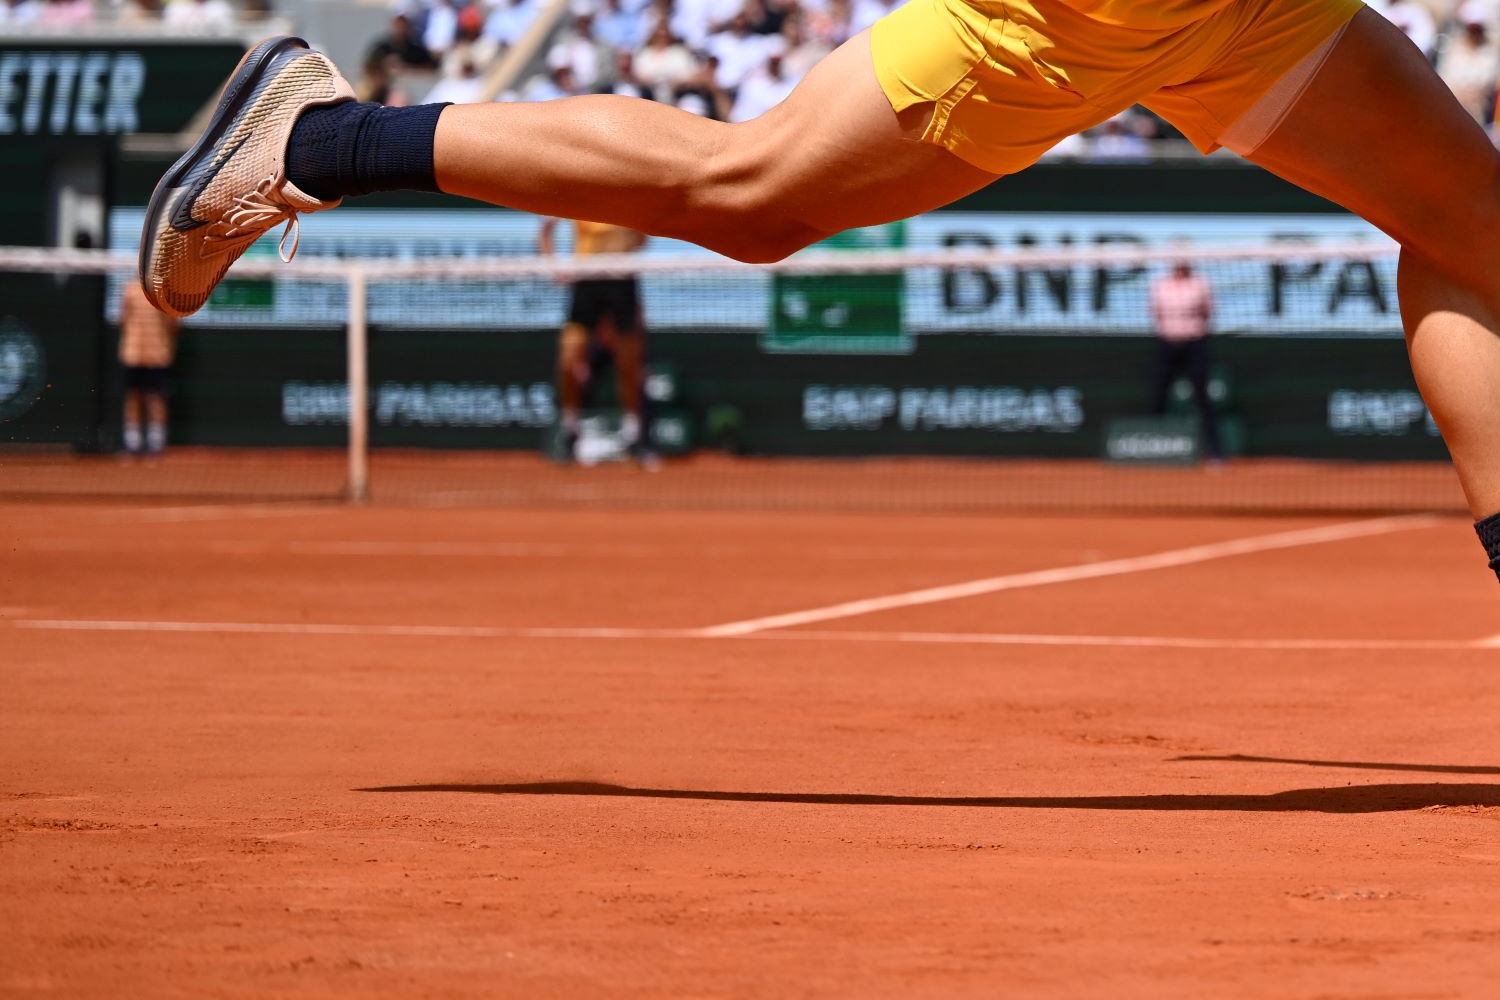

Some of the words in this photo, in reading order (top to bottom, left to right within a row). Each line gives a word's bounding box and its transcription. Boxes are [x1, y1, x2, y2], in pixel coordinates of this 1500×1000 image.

[803, 385, 896, 431] BNP
[900, 386, 1084, 433] PARIBAS
[1328, 389, 1424, 436] BNP
